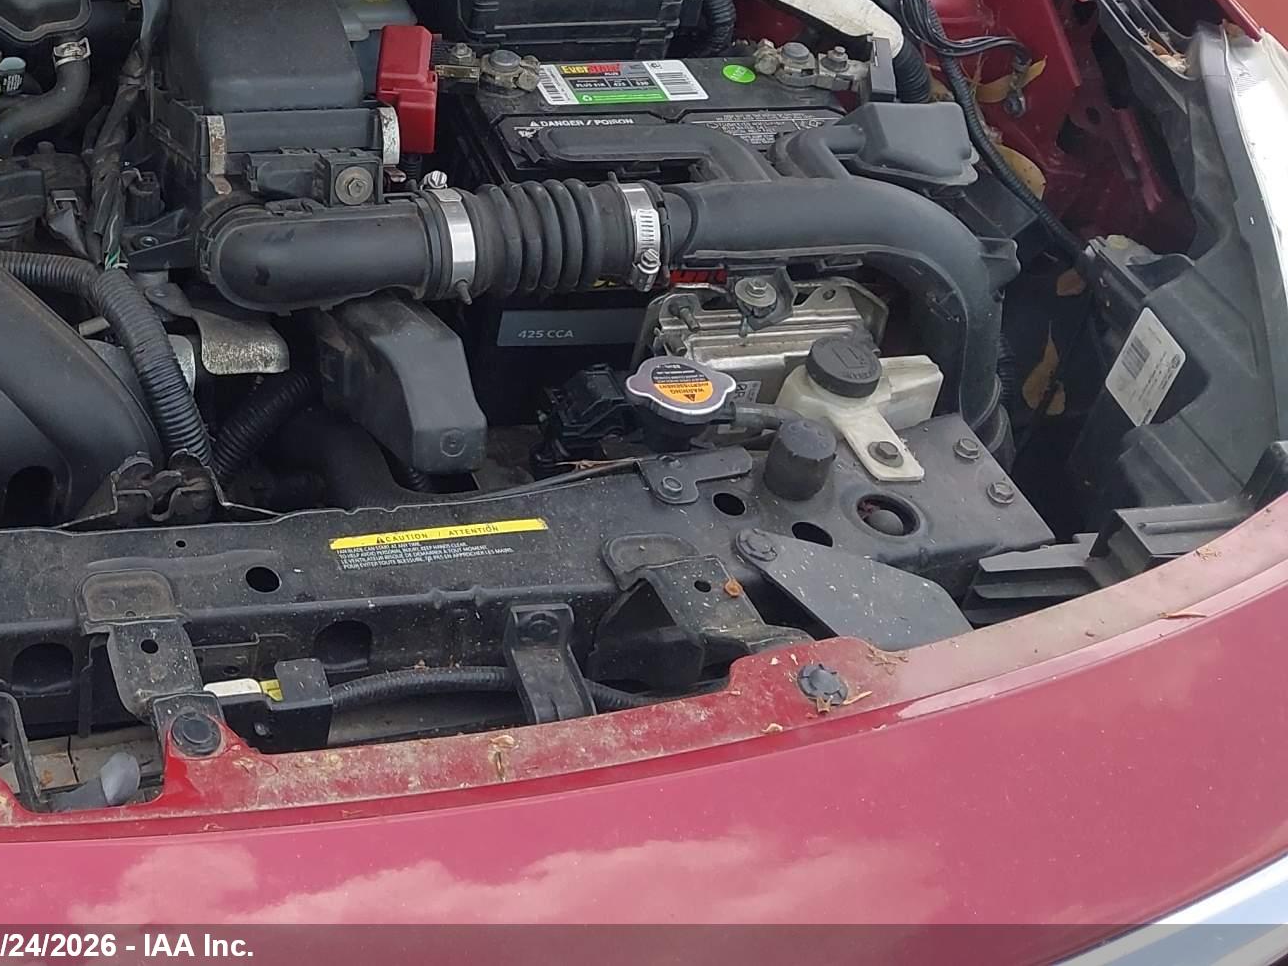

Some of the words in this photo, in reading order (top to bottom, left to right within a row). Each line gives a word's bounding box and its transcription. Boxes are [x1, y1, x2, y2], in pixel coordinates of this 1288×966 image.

[518, 329, 545, 339] 425
[547, 329, 574, 338] CCA
[385, 534, 428, 542] CAUTION
